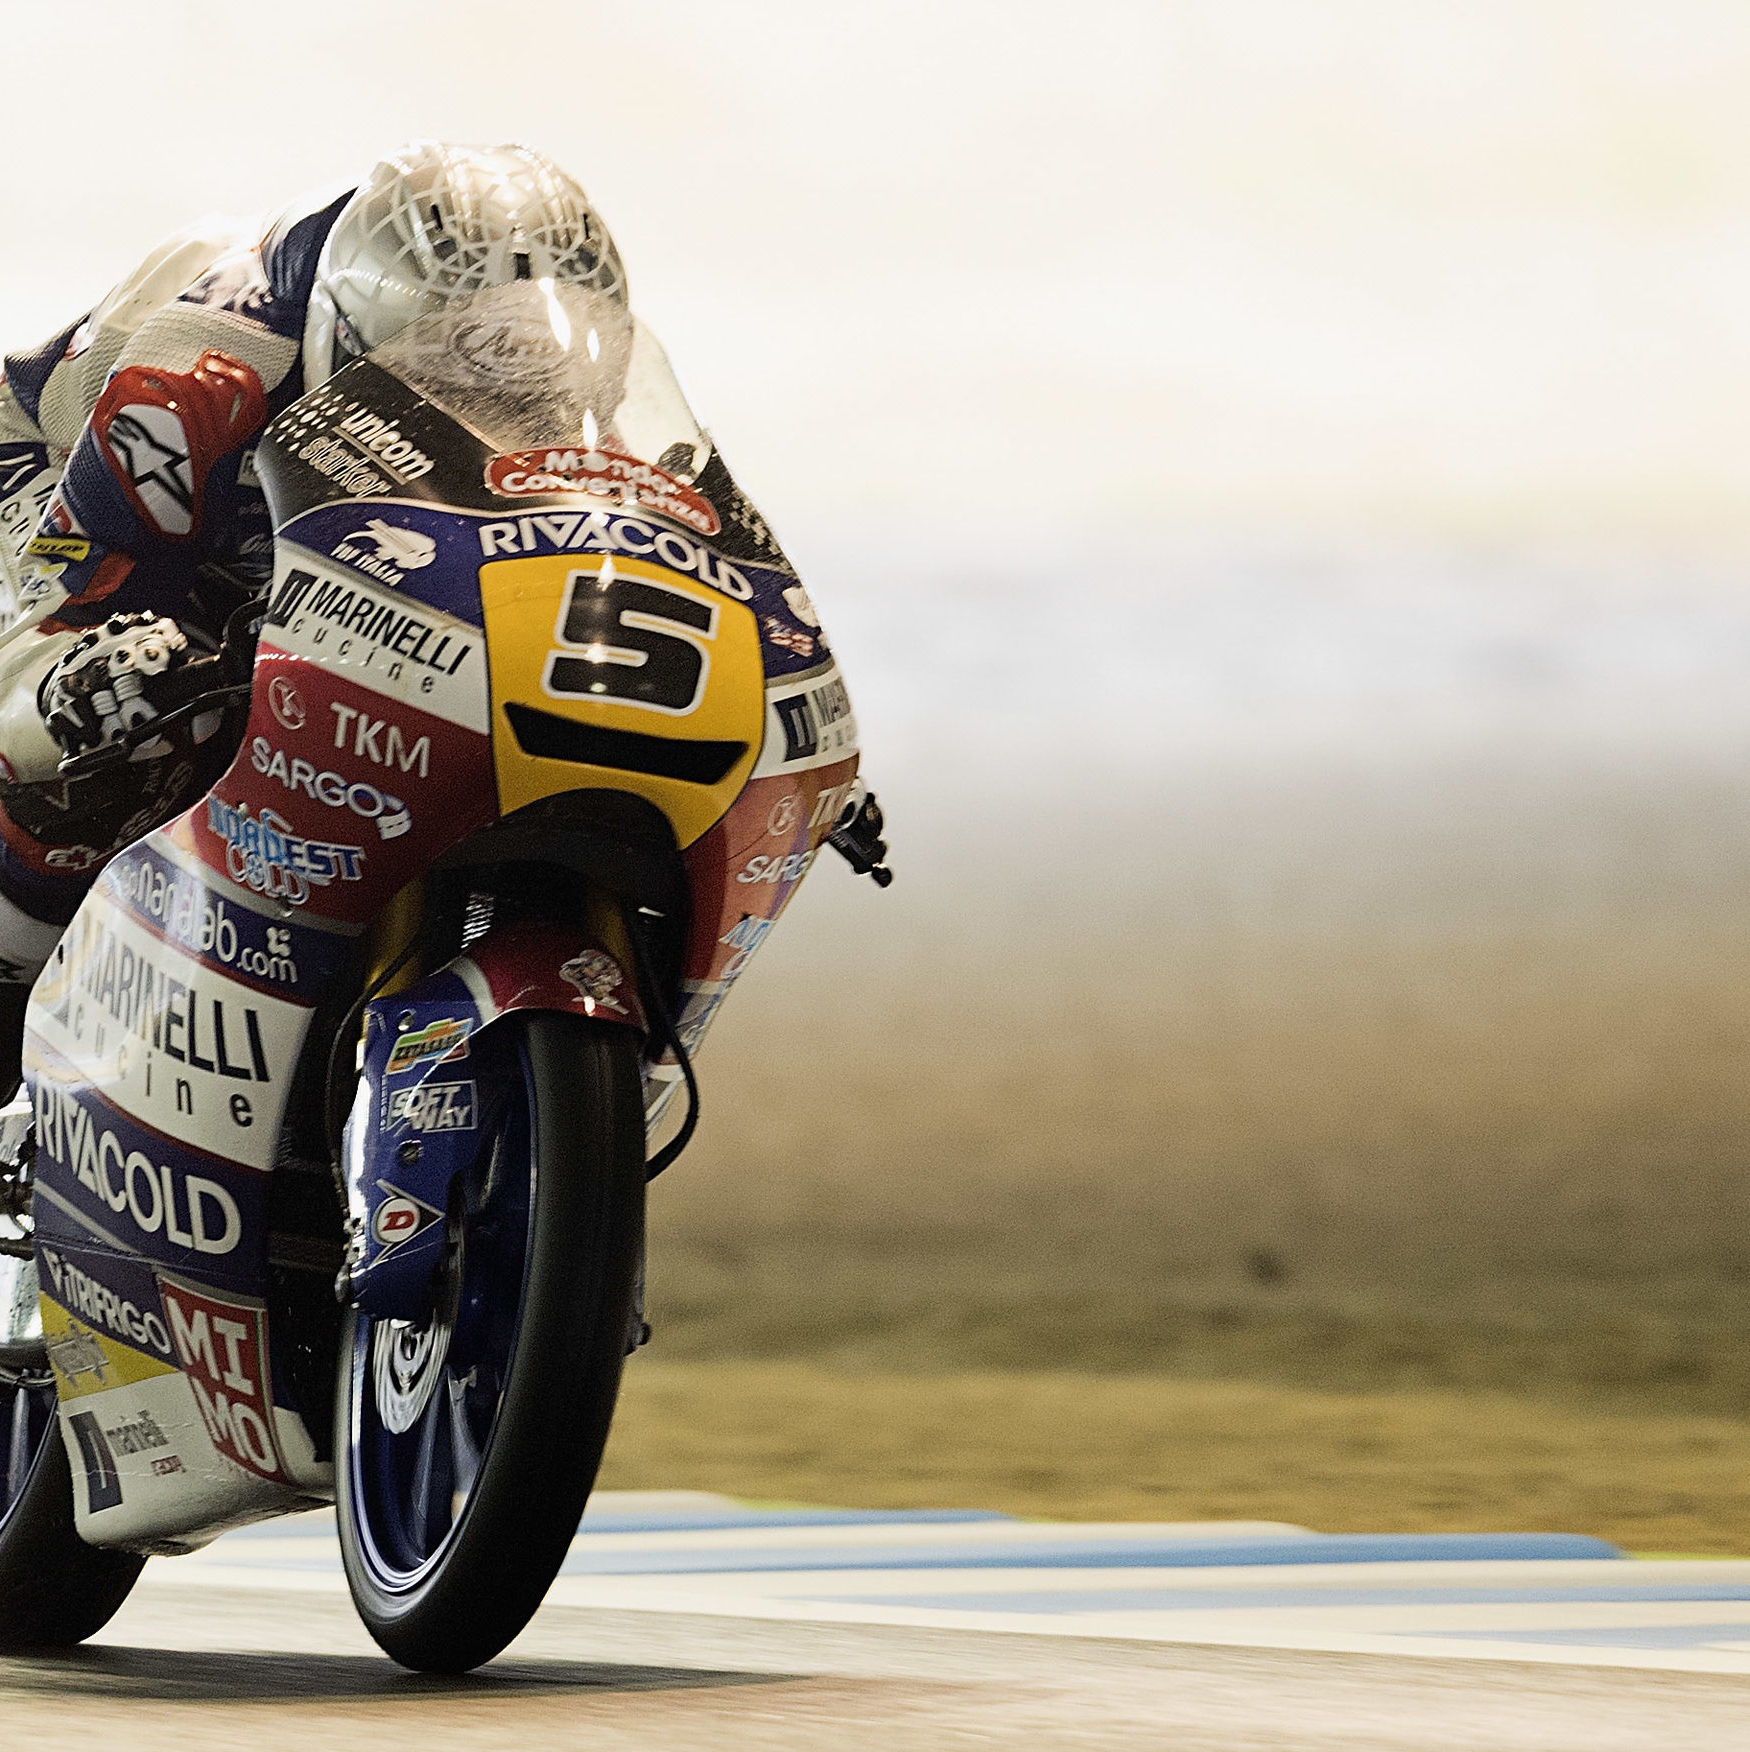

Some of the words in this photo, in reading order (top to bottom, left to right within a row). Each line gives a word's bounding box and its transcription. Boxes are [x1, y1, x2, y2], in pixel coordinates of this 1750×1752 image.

[340, 406, 435, 482] unicom
[354, 553, 406, 587] ITALIA
[478, 511, 753, 601] RIVACOLD
[291, 618, 436, 694] cucine
[306, 581, 472, 676] MARINELLI
[542, 570, 720, 717] 5
[251, 736, 385, 818] SARGO
[330, 702, 431, 778] TKM
[82, 918, 270, 1083] MARINELLI
[390, 1085, 461, 1118] SOFT
[410, 1104, 471, 1130] WAY
[36, 1079, 242, 1255] RIVACOLD
[381, 1210, 415, 1232] D
[165, 1295, 255, 1396] MI
[192, 1375, 278, 1474] MO
